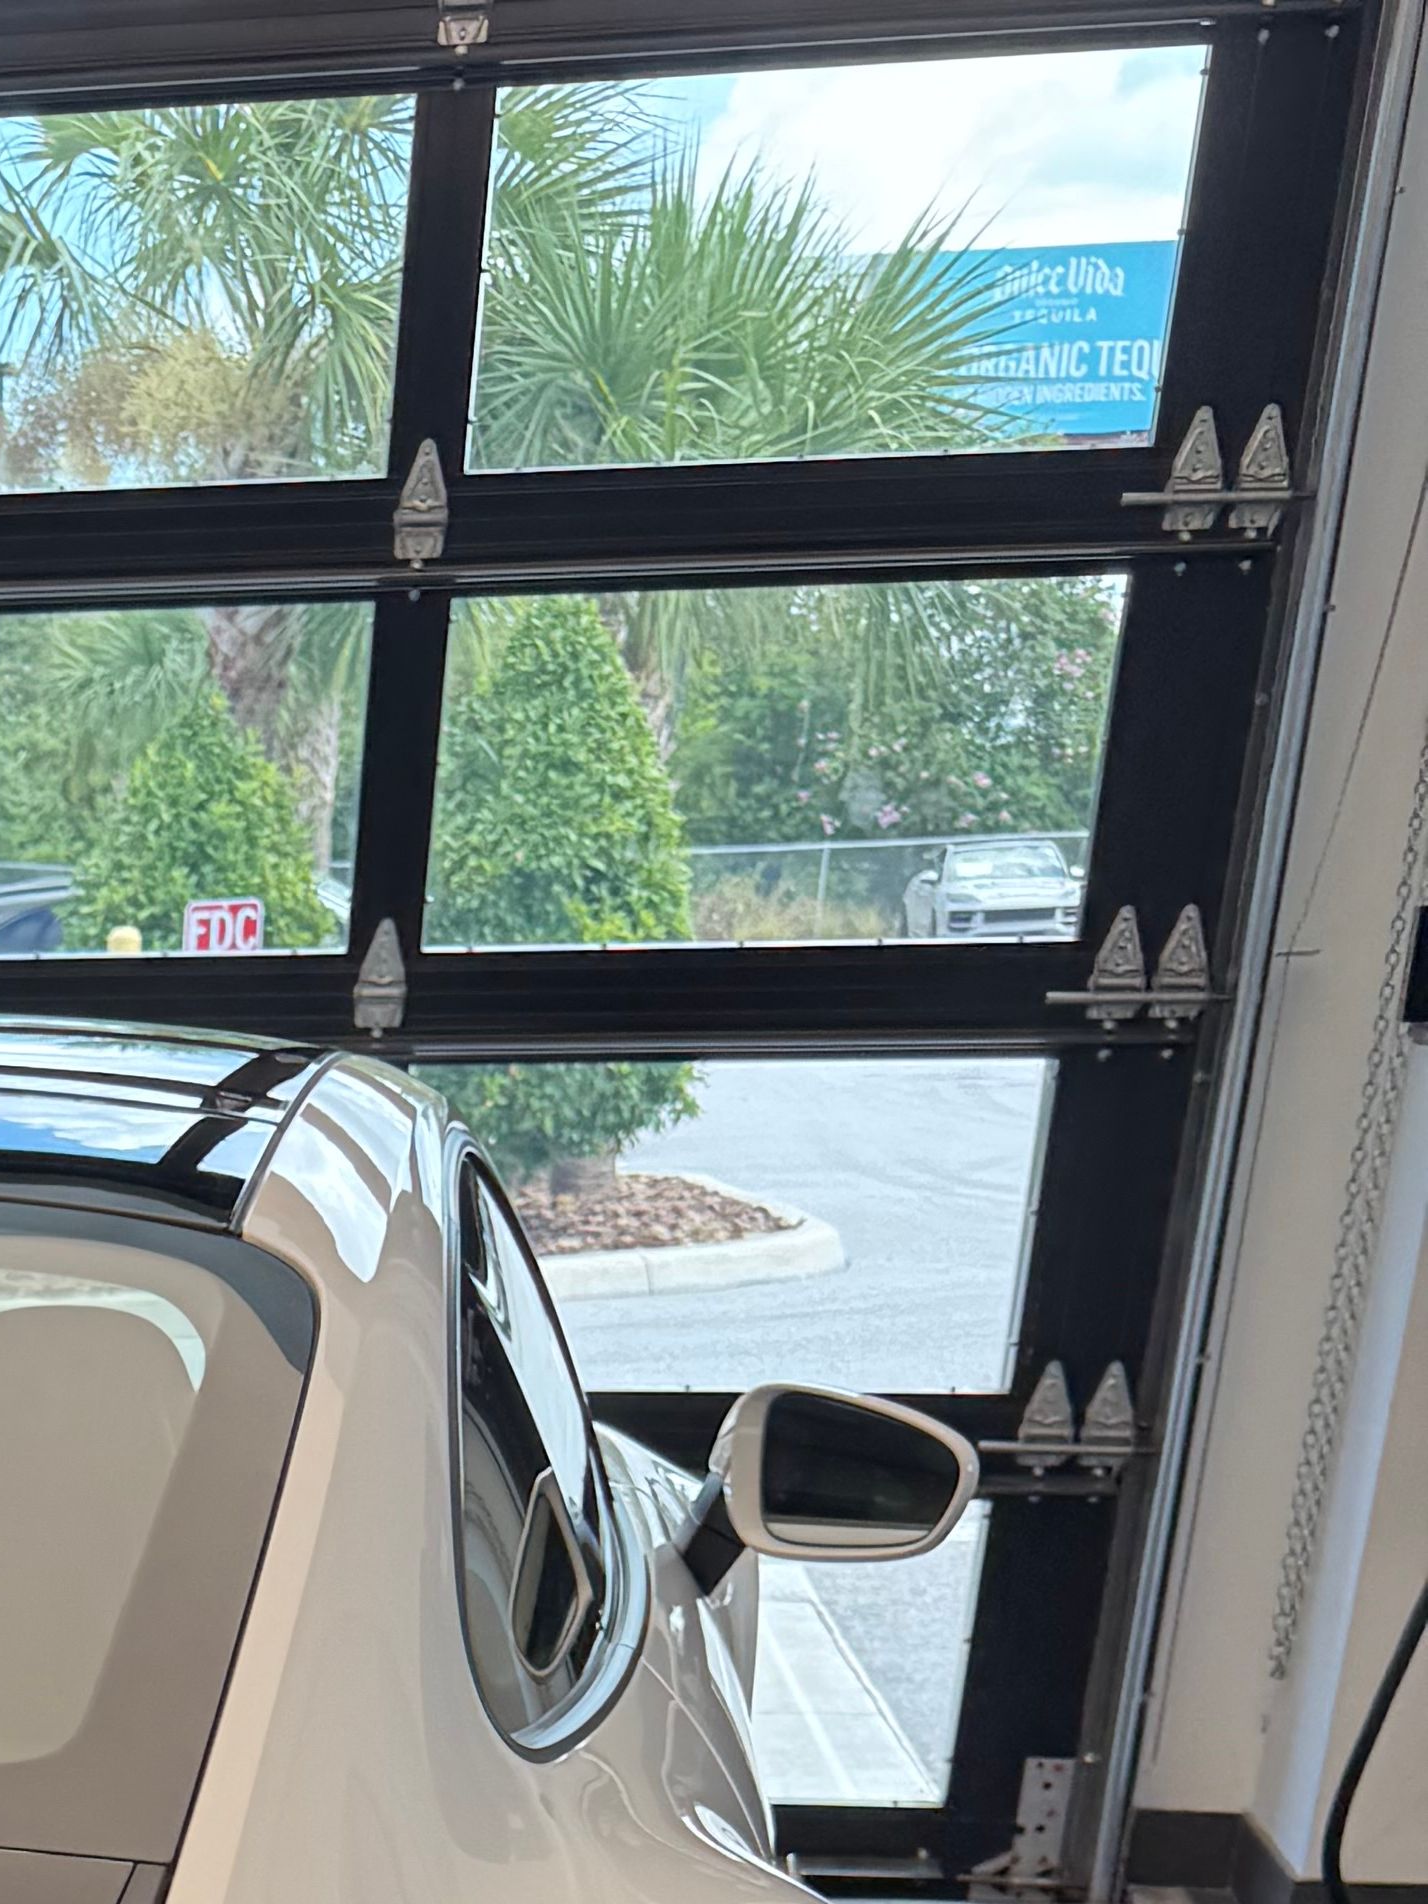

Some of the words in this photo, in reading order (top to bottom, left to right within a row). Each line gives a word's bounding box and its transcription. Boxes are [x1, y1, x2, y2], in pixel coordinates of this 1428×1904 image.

[1067, 256, 1126, 296] Vida
[1012, 307, 1098, 324] TEQUILA
[189, 906, 258, 951] FDC
